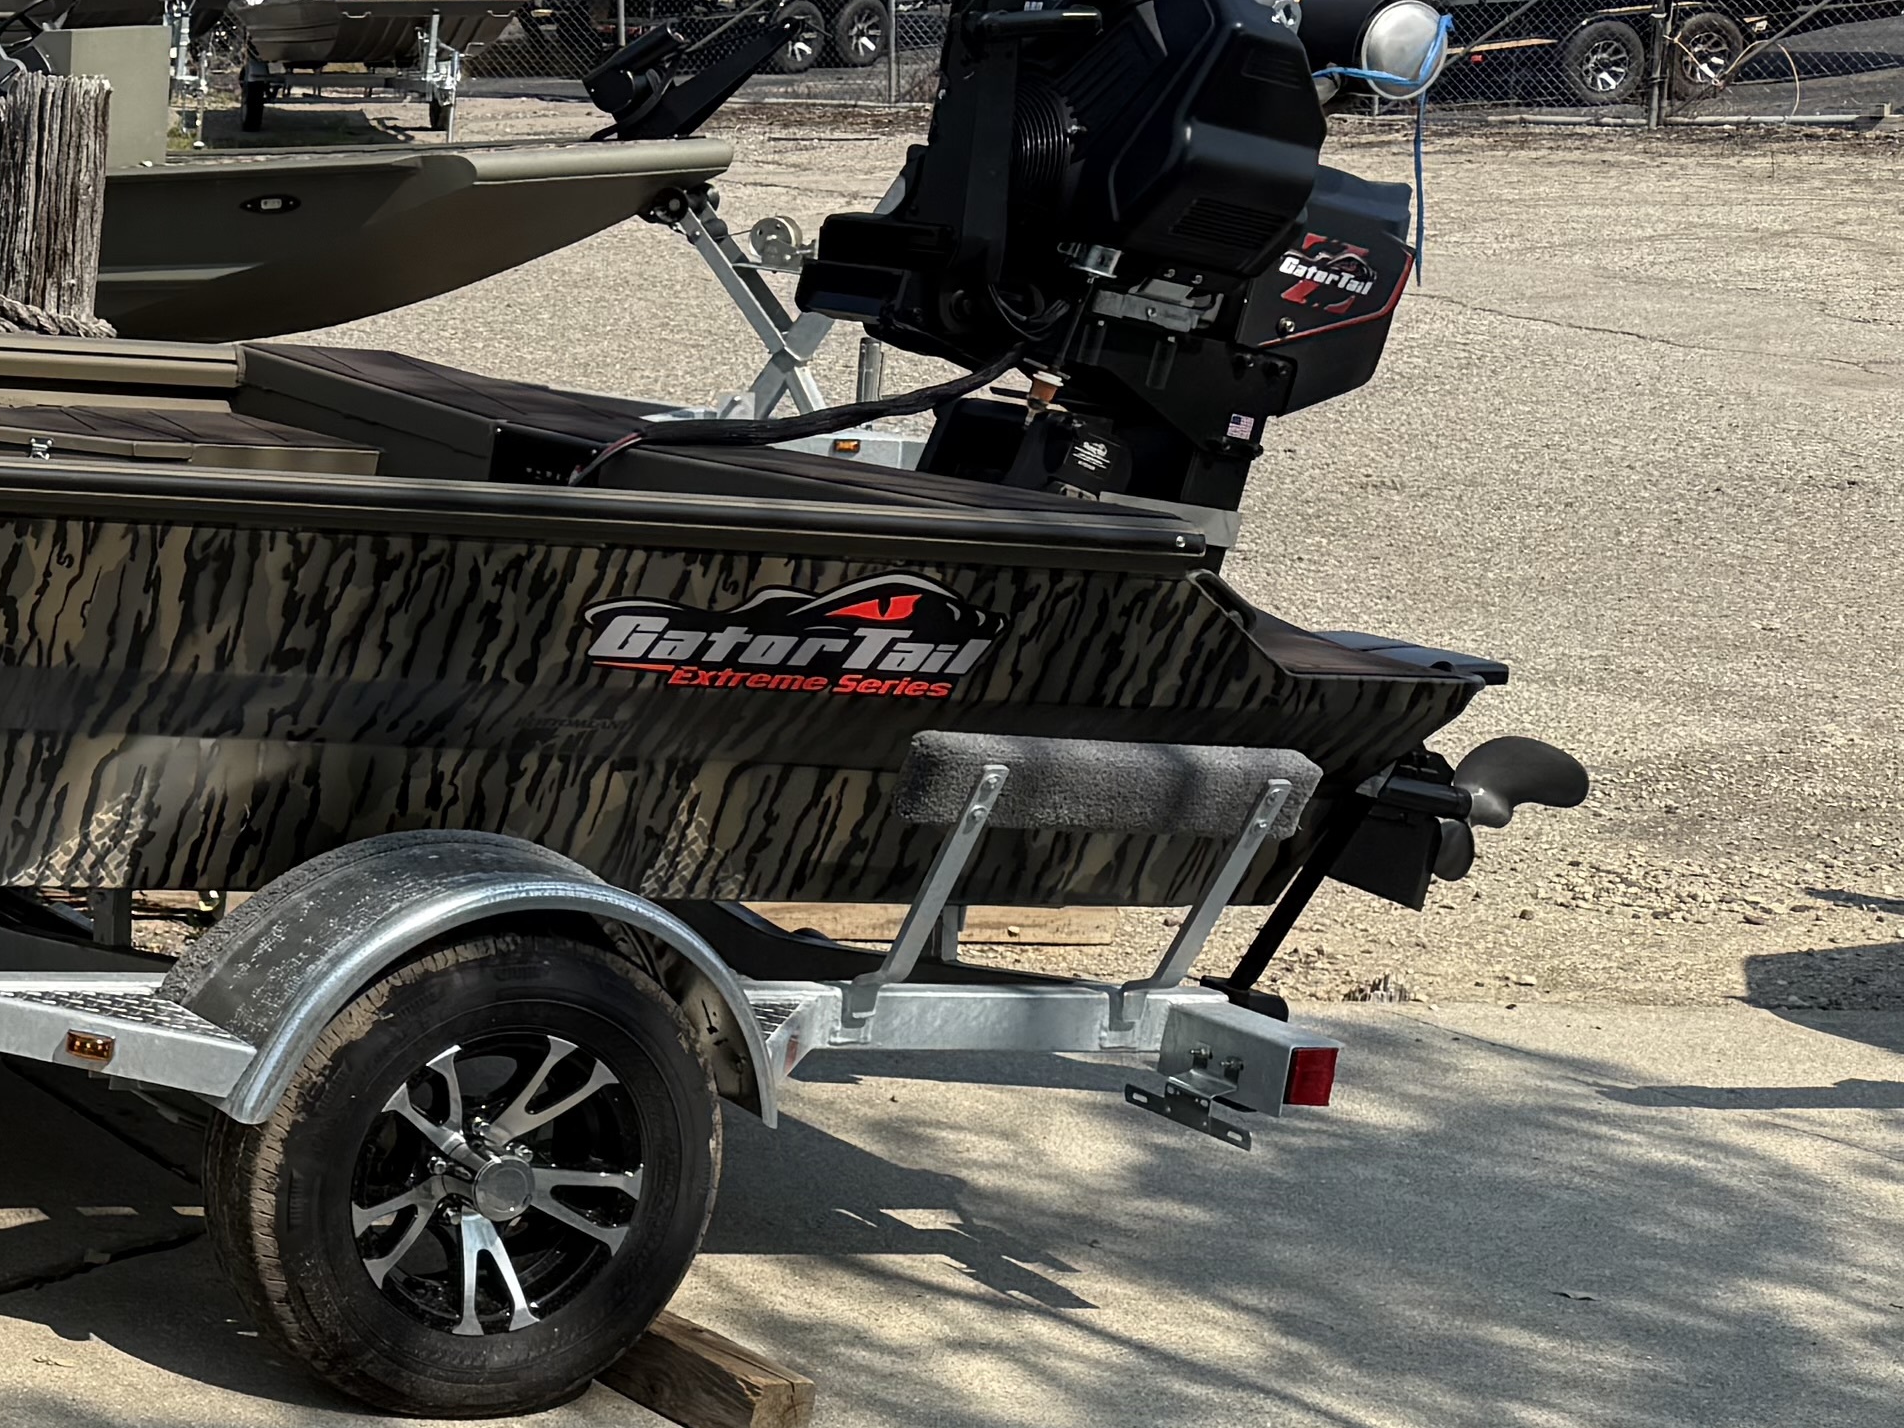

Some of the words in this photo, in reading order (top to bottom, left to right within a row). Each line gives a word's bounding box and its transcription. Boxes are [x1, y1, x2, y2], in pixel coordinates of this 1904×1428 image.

[1278, 256, 1373, 295] GatorTail
[587, 615, 992, 675] GatorTail
[667, 667, 828, 691] Extreme
[832, 674, 953, 698] Series
